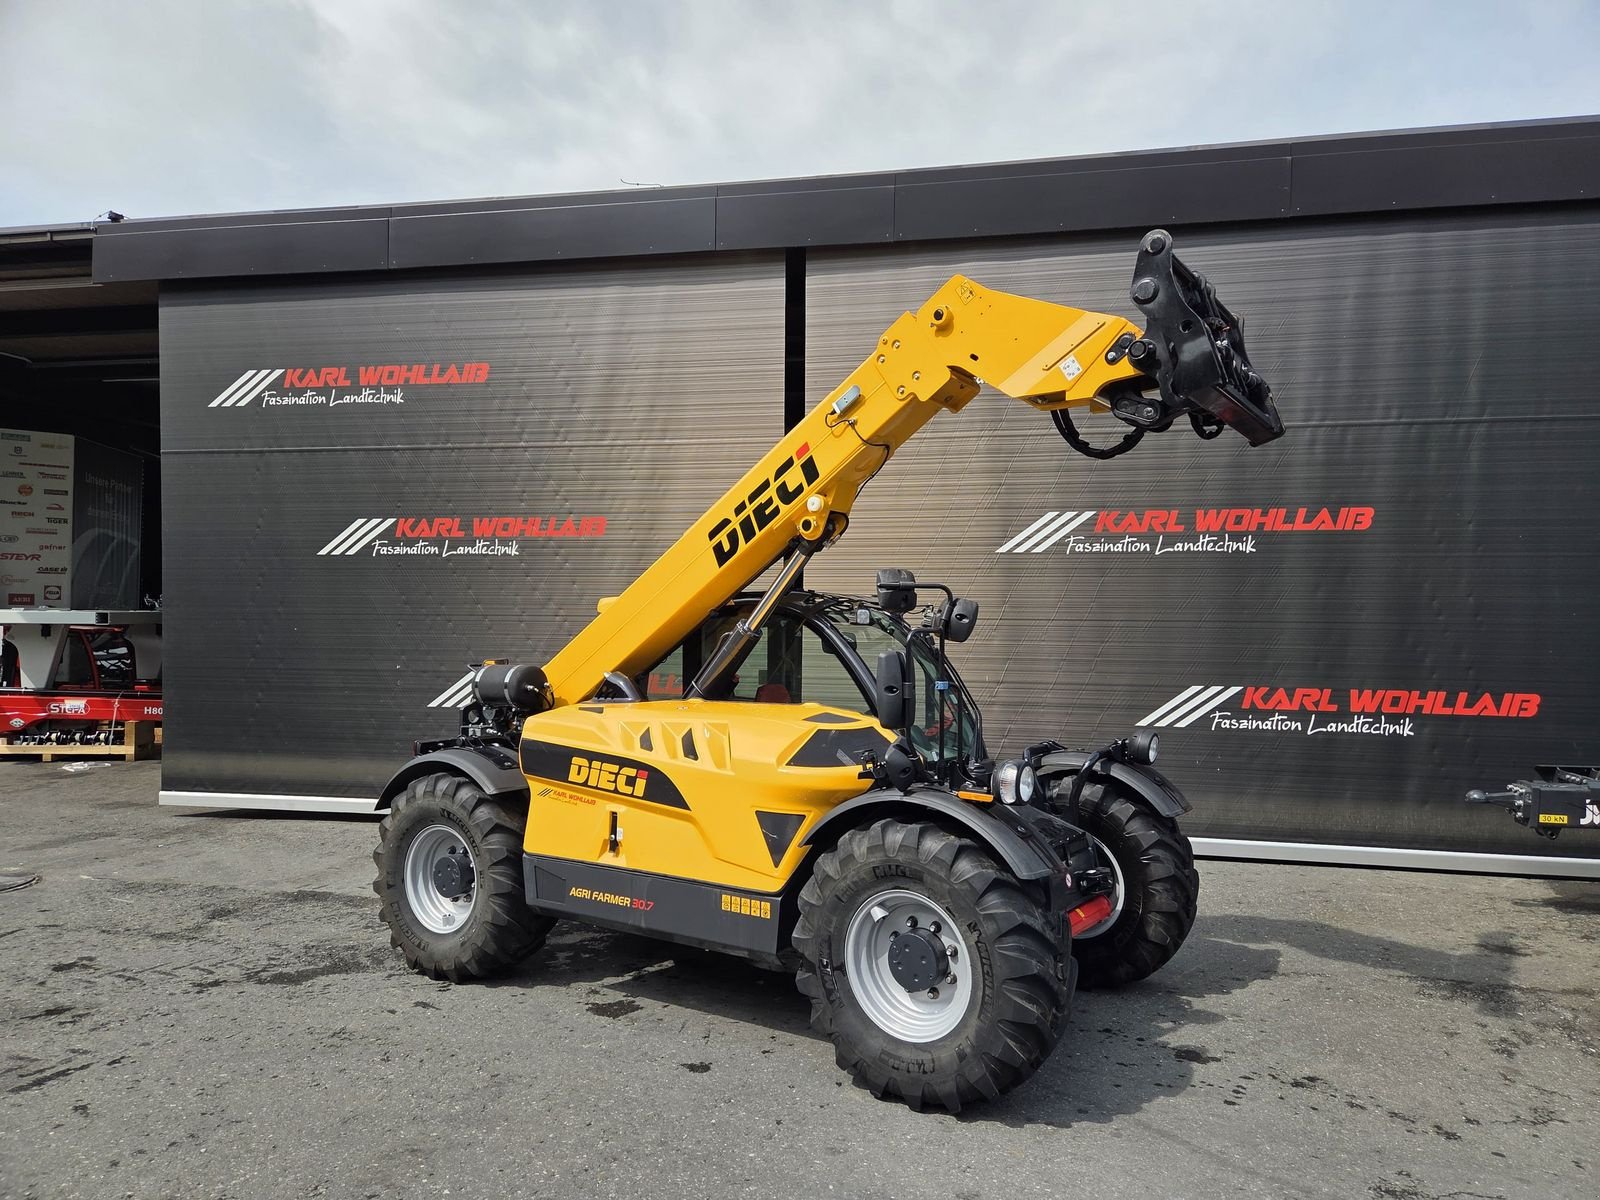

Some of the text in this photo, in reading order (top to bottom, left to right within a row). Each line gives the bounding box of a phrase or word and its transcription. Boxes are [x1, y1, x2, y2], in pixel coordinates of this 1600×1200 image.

[284, 363, 490, 388] KARL WOHLLAIB
[261, 387, 404, 408] Faszination Landtechnik
[396, 516, 607, 537] KARL WOHLLAIB
[1095, 507, 1375, 533] KARL WOHLLAIB
[371, 539, 519, 558] Faszination Landtechnik
[1065, 534, 1256, 555] Faszination Landtechnik
[0, 552, 41, 561] STEYR
[1241, 686, 1541, 718] KARL WOHLLAIB
[1210, 711, 1415, 737] Faszination Landtechnik
[569, 886, 654, 911] AGRI FARMER 30.7
